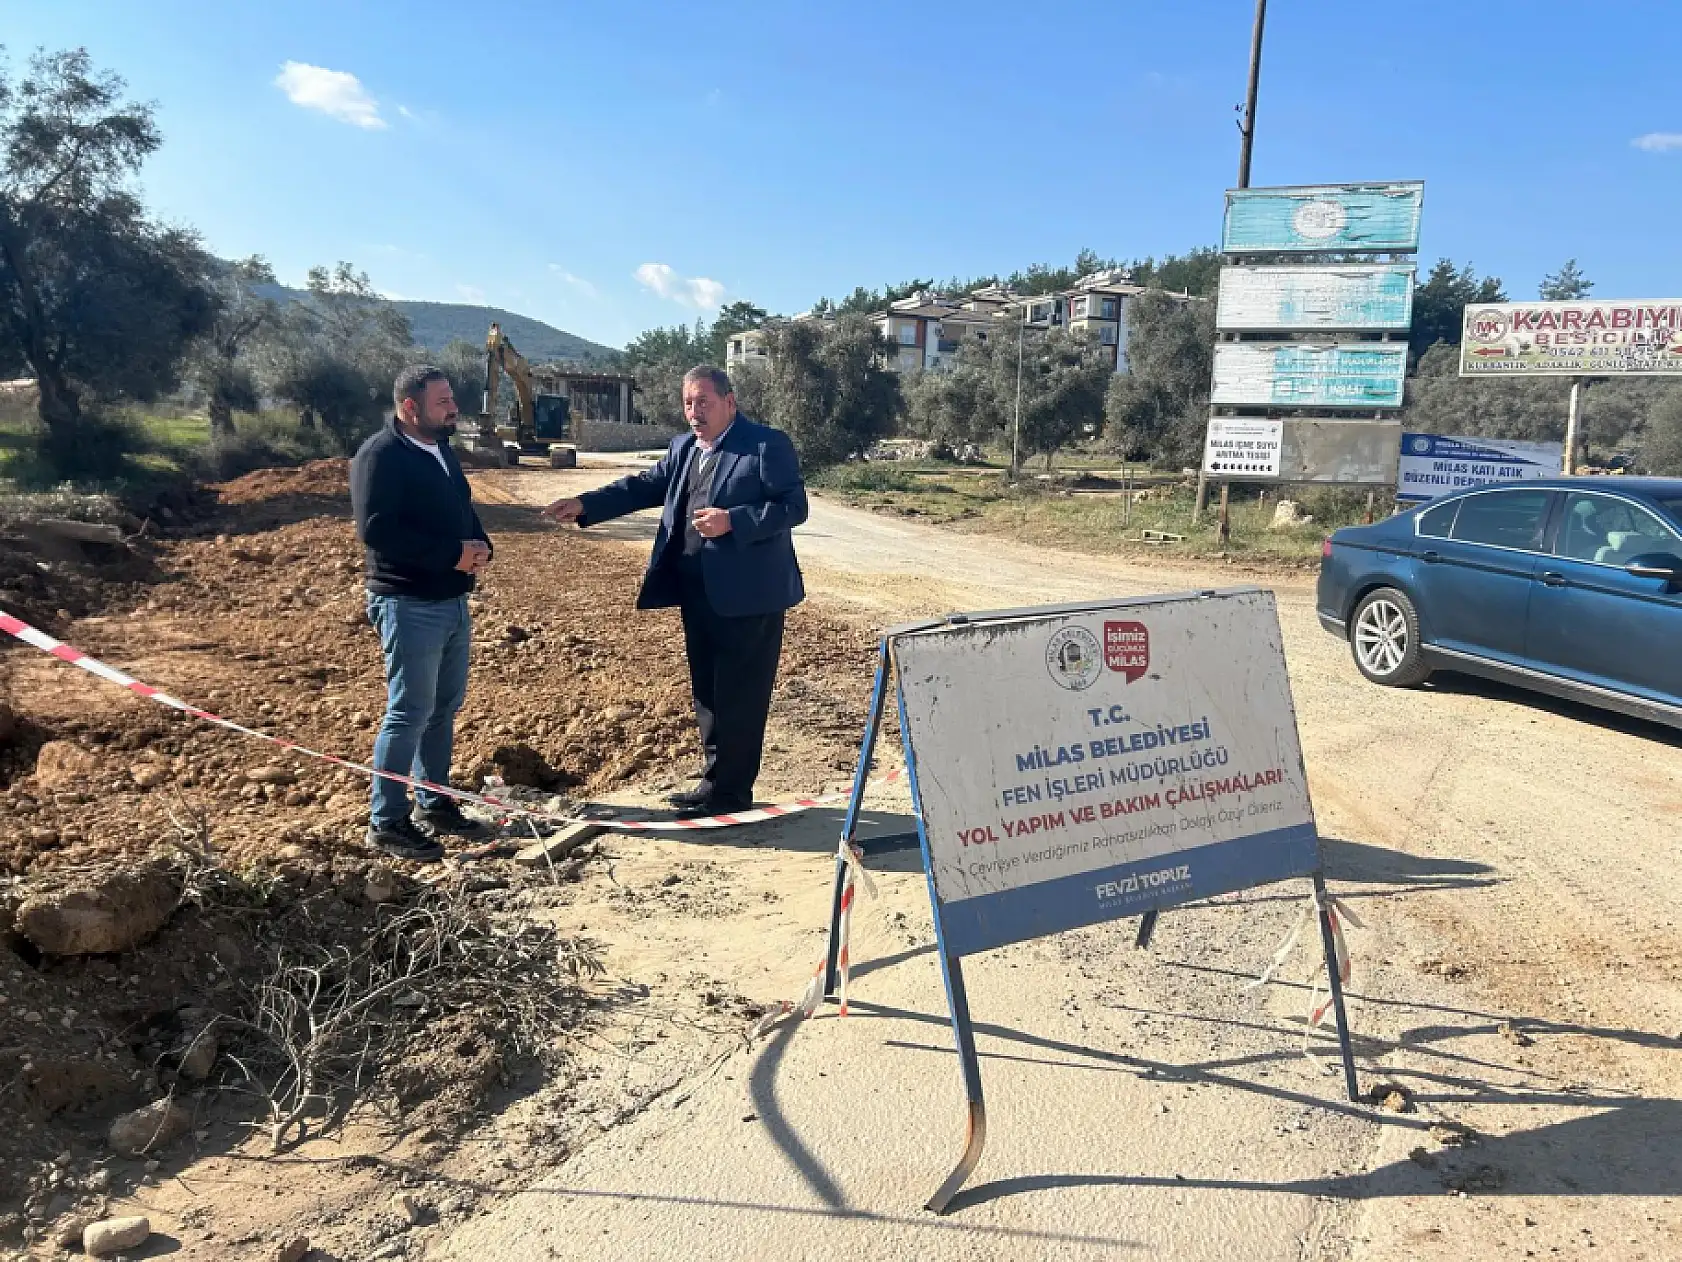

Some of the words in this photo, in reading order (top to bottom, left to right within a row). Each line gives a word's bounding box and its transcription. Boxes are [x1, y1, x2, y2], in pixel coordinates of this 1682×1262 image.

[1512, 308, 1682, 331] KARABIYI
[1087, 705, 1130, 727] T.C.
[1016, 743, 1085, 771] MİLAS
[1088, 716, 1211, 759] BELEDİYESİ
[1002, 784, 1042, 807] FEN
[1045, 767, 1105, 802] İŞLERİ
[1109, 745, 1229, 786] MÜDÜRLÜĞÜ
[957, 826, 1000, 847] YOL
[1001, 812, 1066, 838] YAPIM
[1069, 805, 1096, 825] VE
[1099, 792, 1162, 819] BAKIM
[1164, 768, 1284, 810] ÇALIŞMALARI
[1022, 841, 1089, 864] Verdiğimiz
[1092, 822, 1177, 849] Rahatsızlıktan
[1096, 872, 1140, 899] FEVZİ
[1139, 864, 1192, 889] TOPUZ
